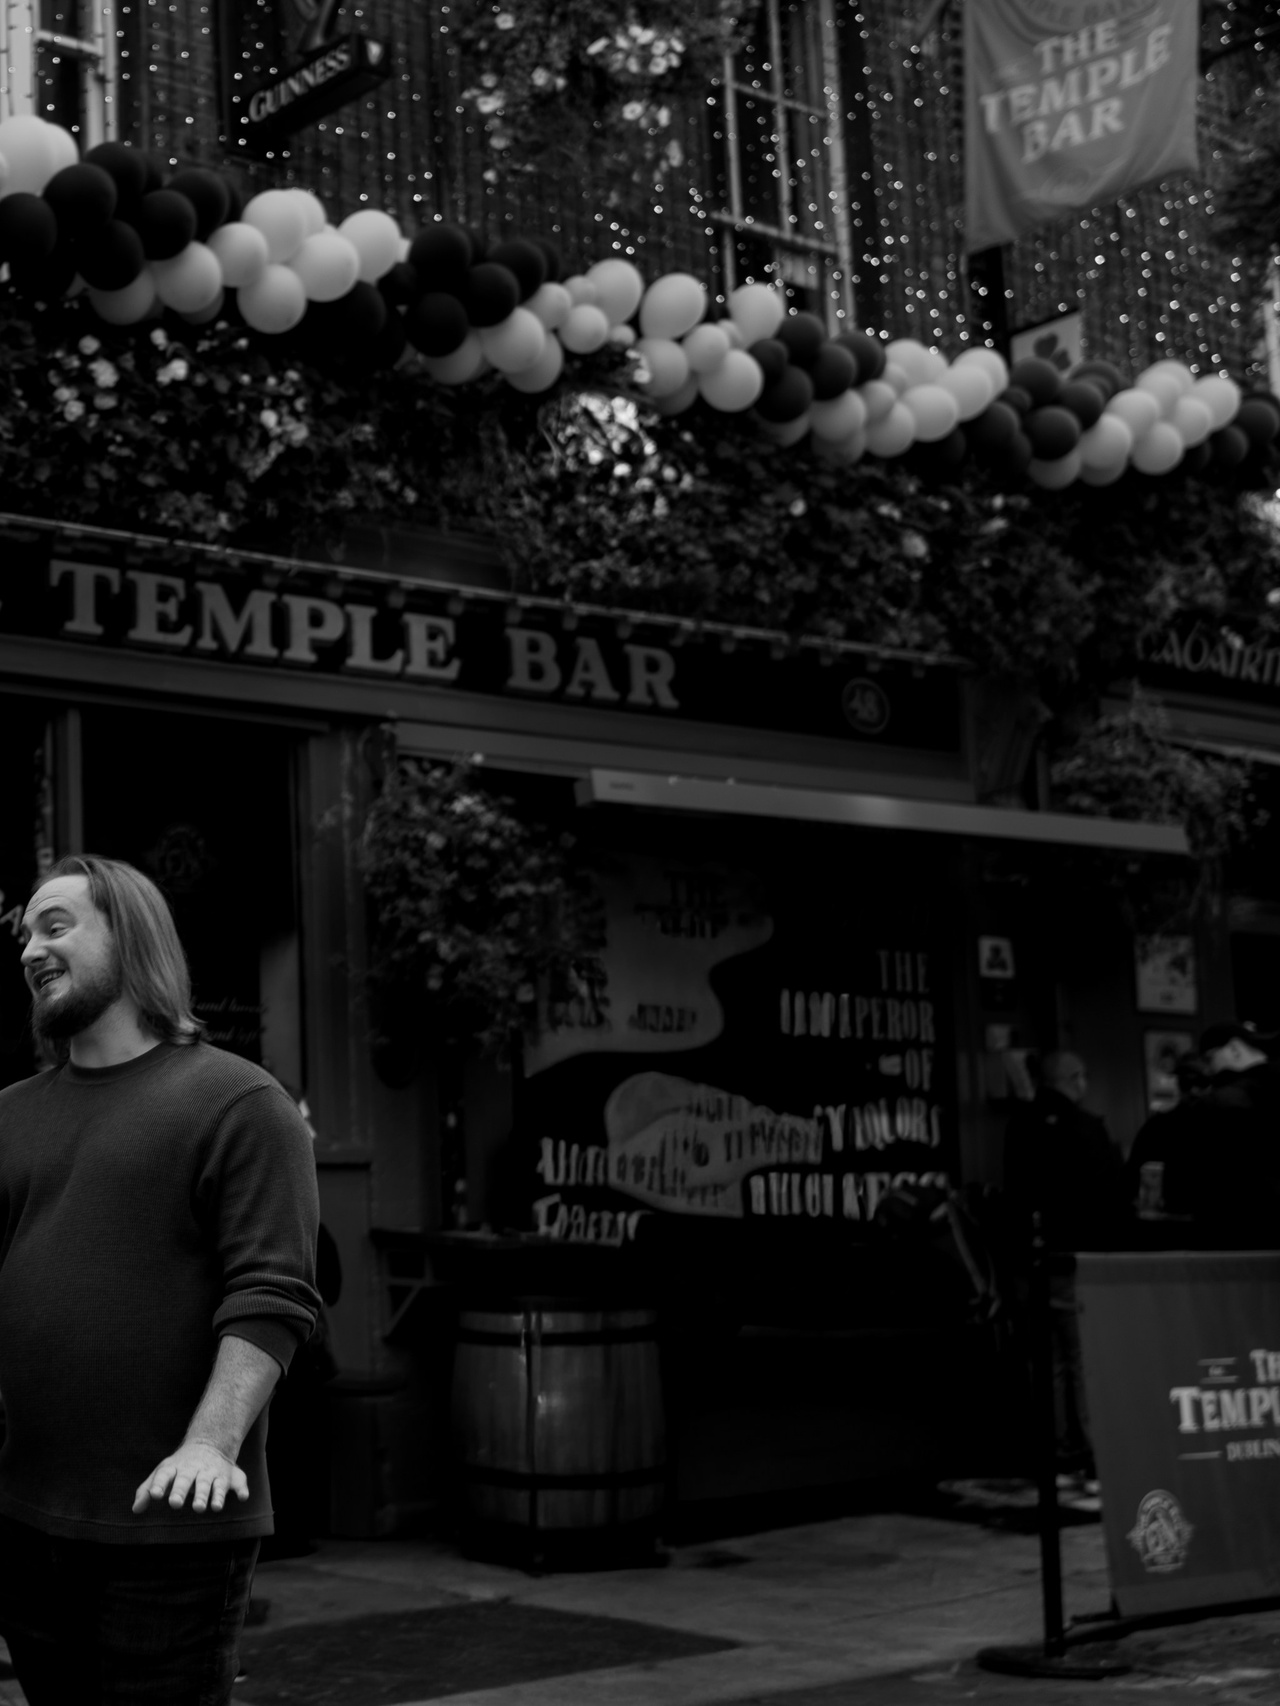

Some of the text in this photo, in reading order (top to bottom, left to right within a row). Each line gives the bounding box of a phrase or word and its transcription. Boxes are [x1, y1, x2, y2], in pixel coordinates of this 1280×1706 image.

[248, 42, 352, 123] GUINNESS
[980, 22, 1173, 134] TEMPLE
[1034, 18, 1120, 74] THE
[1020, 97, 1126, 164] BAR
[49, 558, 462, 682] TEMPLE
[502, 626, 681, 710] BAR
[875, 948, 930, 995] THE
